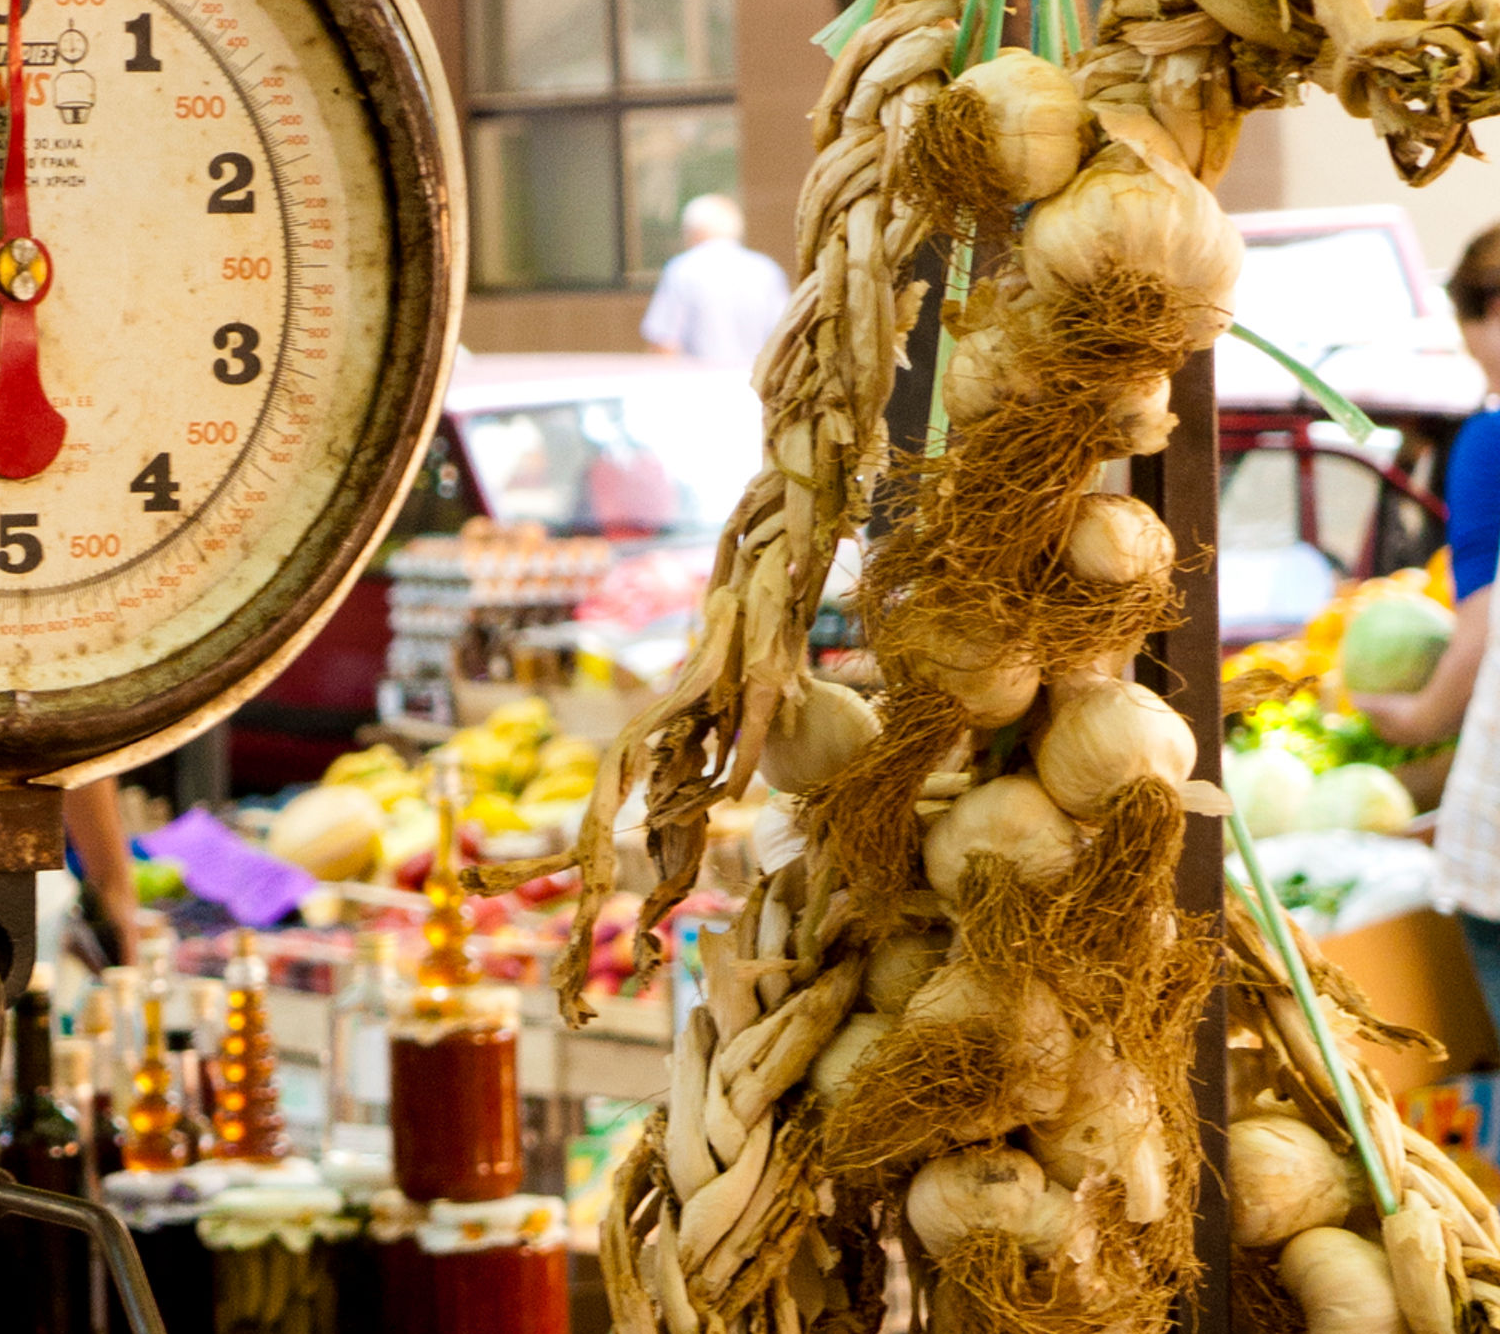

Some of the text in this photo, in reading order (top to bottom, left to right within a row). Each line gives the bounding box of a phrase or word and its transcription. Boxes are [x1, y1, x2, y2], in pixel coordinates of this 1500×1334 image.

[124, 12, 162, 72] 1
[174, 95, 226, 119] 500
[207, 152, 255, 213] 2
[221, 256, 273, 281] 500
[212, 322, 261, 385] 3
[186, 420, 238, 445] 500
[130, 451, 180, 512] 4
[69, 533, 121, 558] 500
